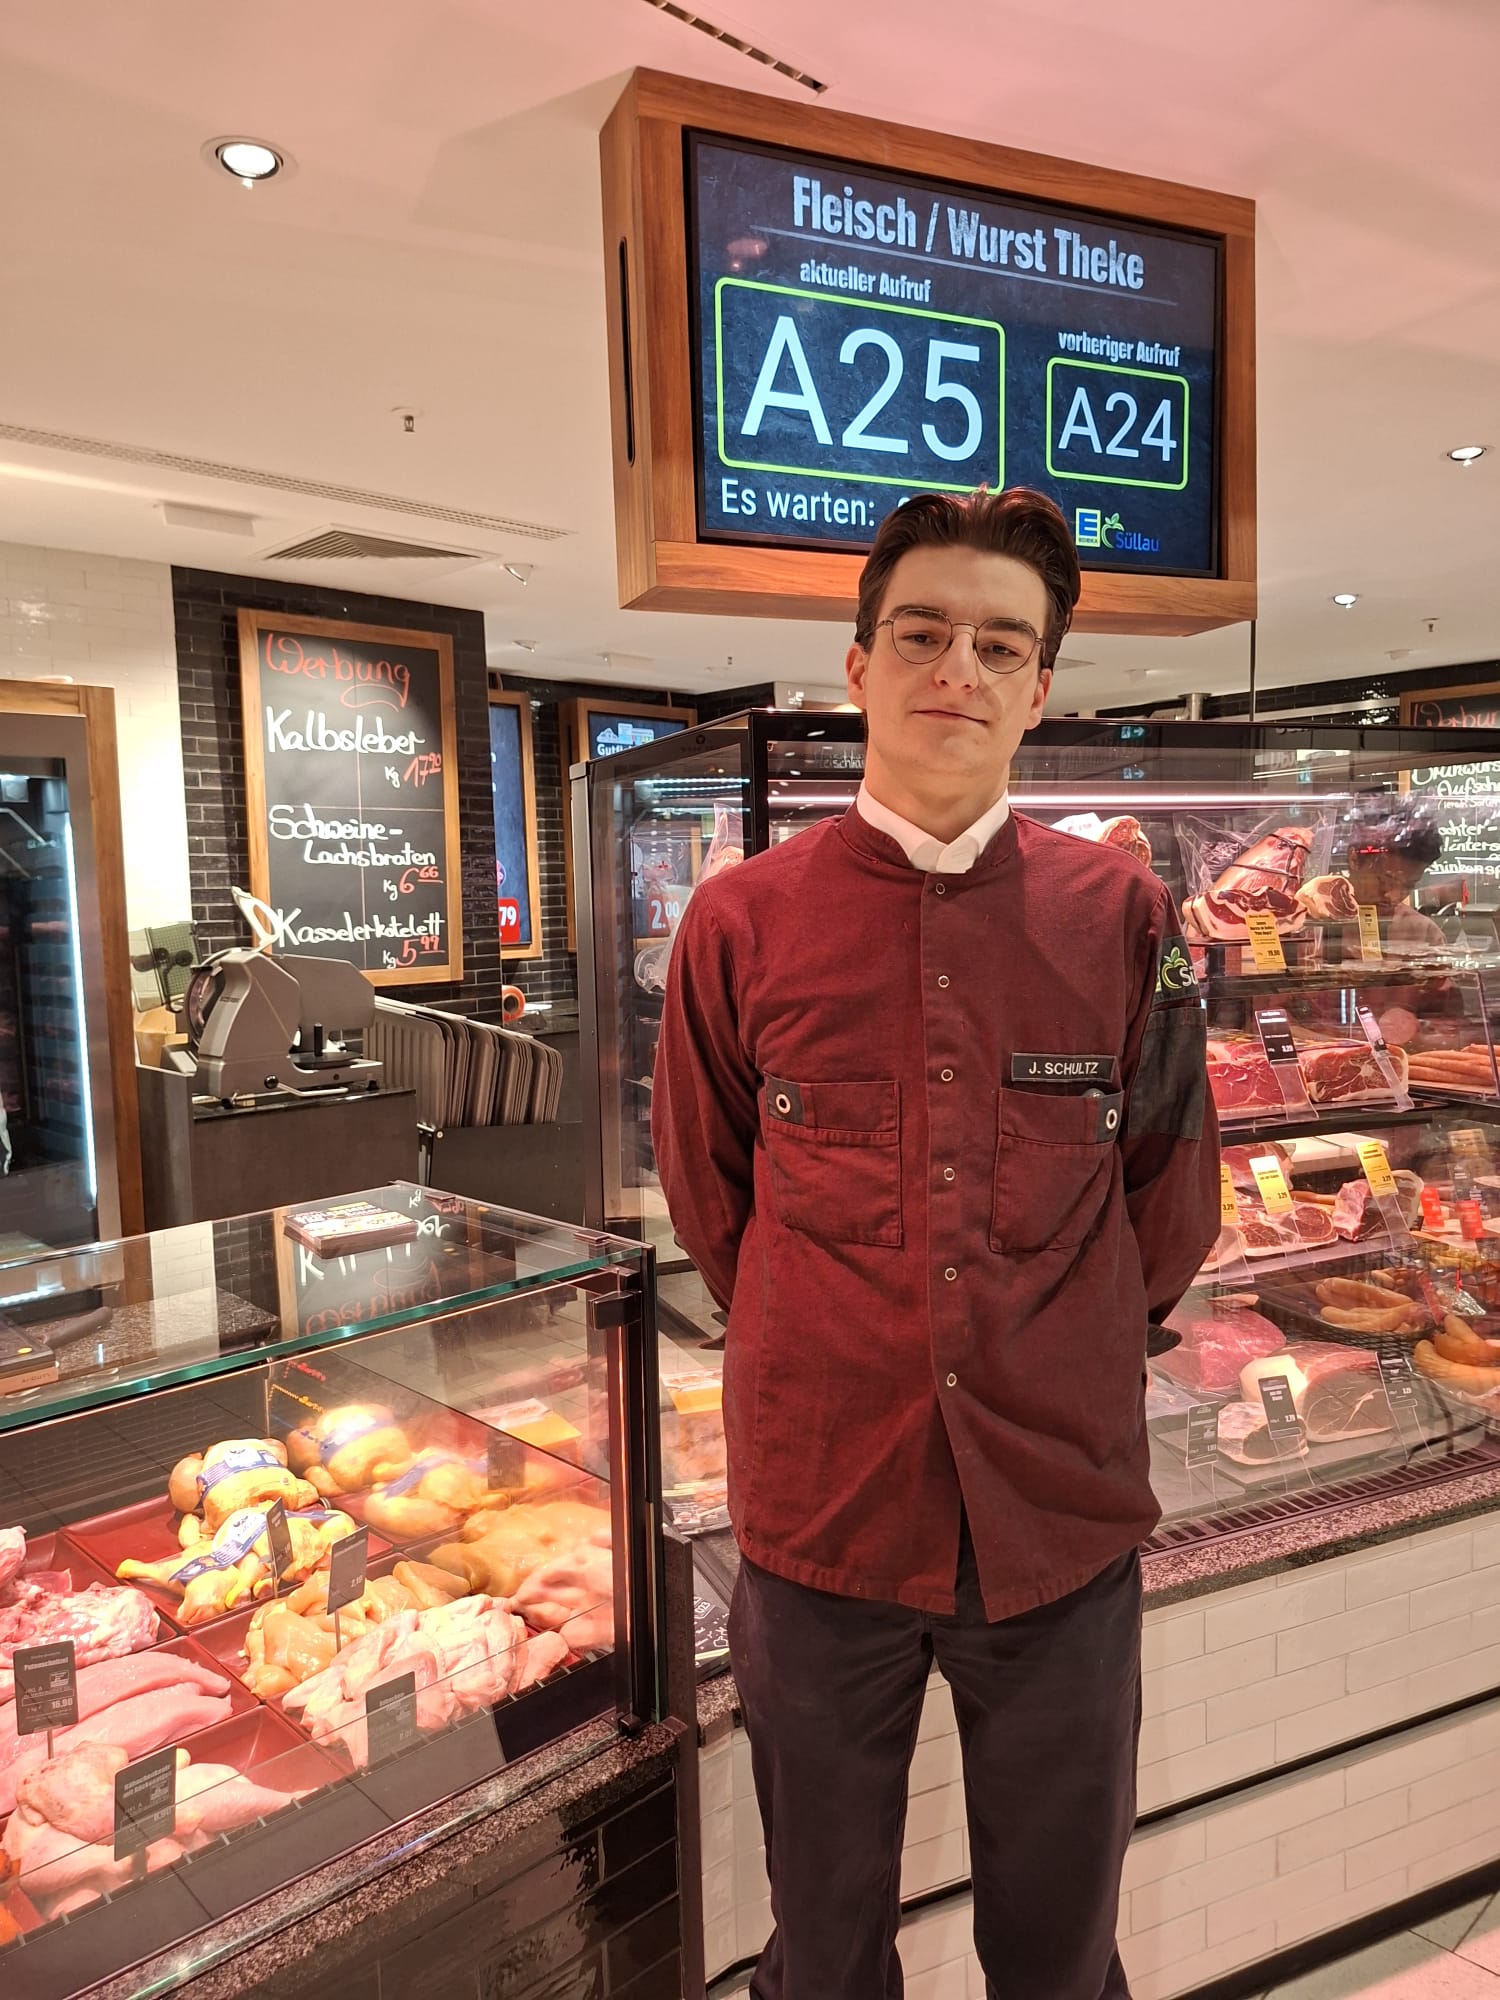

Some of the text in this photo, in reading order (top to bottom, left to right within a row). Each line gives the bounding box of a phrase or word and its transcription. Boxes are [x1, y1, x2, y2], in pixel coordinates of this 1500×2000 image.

[793, 176, 1144, 289] Fleisch / Wurst Theke
[800, 259, 932, 302] aktueller Aufruf
[1058, 331, 1181, 367] vorheriger Aufruf
[740, 315, 982, 461] A25
[1058, 386, 1177, 461] A24
[721, 478, 875, 527] Es warten:
[1115, 531, 1160, 551] Süllau
[265, 633, 411, 708] Werbung
[266, 706, 426, 755] Kalbsleber
[384, 766, 401, 788] Kg
[268, 803, 403, 840] Schweine-
[304, 840, 436, 867] Lachsbraten
[383, 879, 399, 901] Kg
[278, 908, 446, 947] Kasselerkotelett
[1029, 1061, 1099, 1075] J. SCHULTZ
